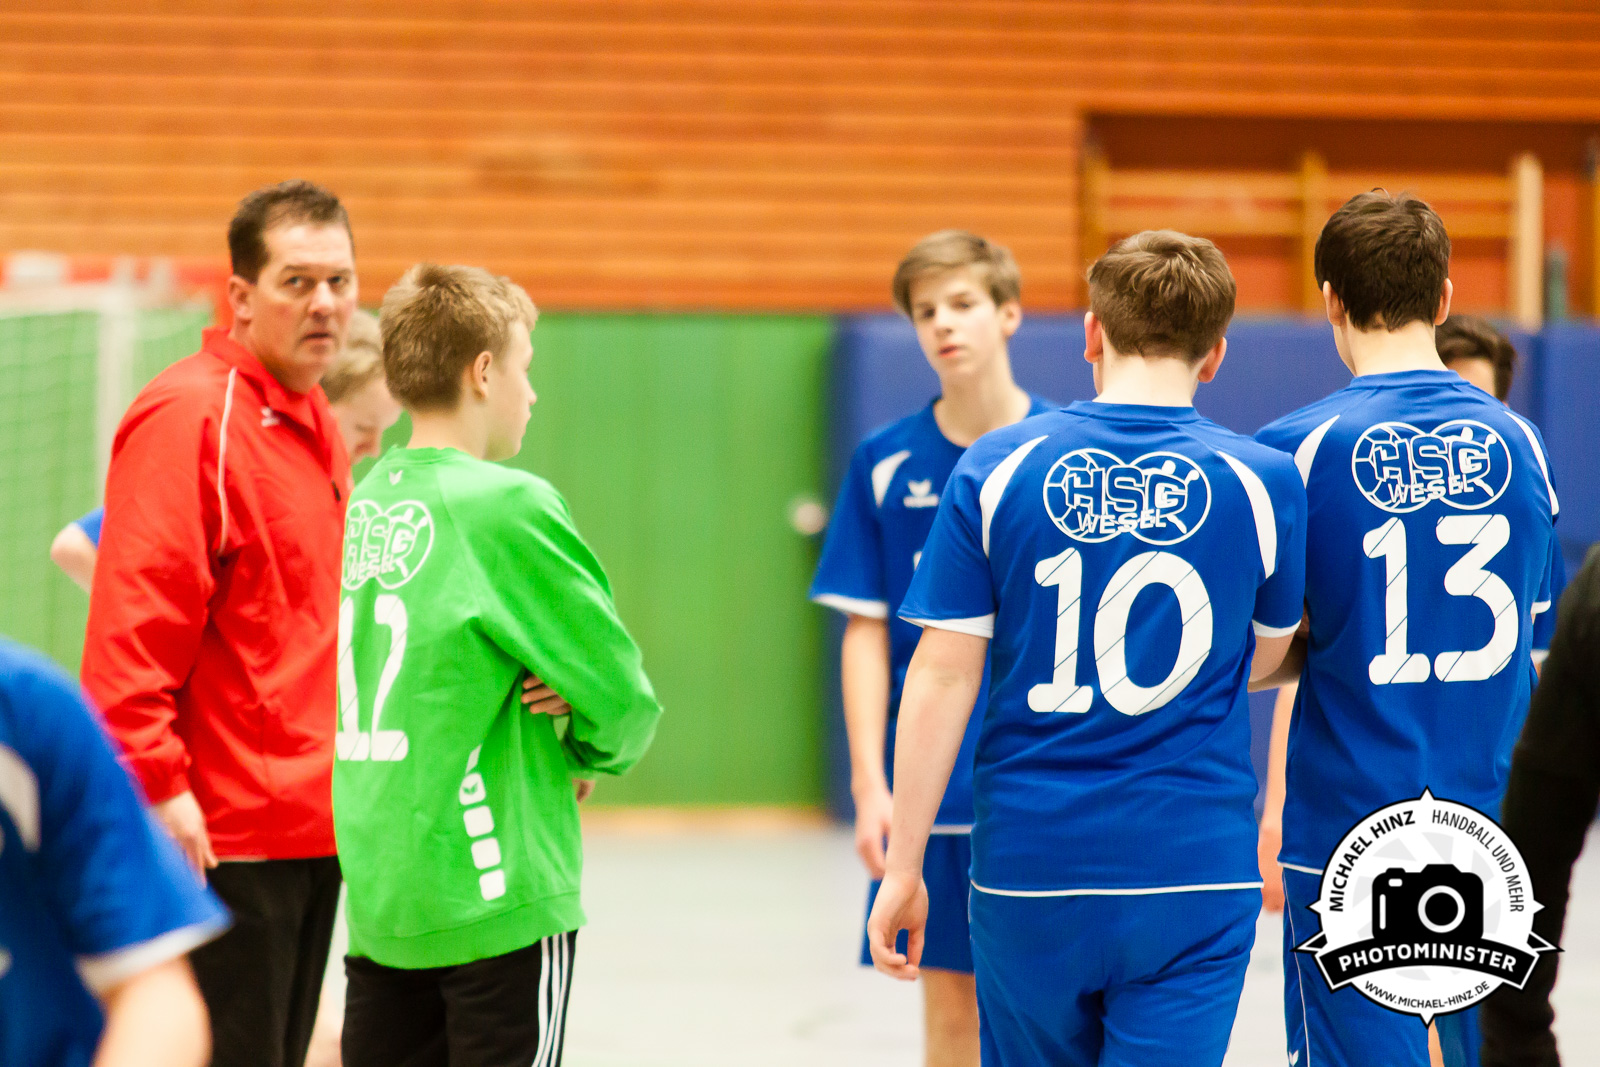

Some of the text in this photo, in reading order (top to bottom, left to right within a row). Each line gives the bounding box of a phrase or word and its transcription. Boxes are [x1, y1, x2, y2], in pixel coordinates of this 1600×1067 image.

[1373, 433, 1492, 490] HSG
[1388, 472, 1475, 504] WESEL
[1065, 464, 1189, 519] HSG
[1077, 508, 1168, 535] WESEL
[1362, 514, 1519, 686] 13
[1027, 547, 1214, 716] 10
[335, 594, 410, 762] 12
